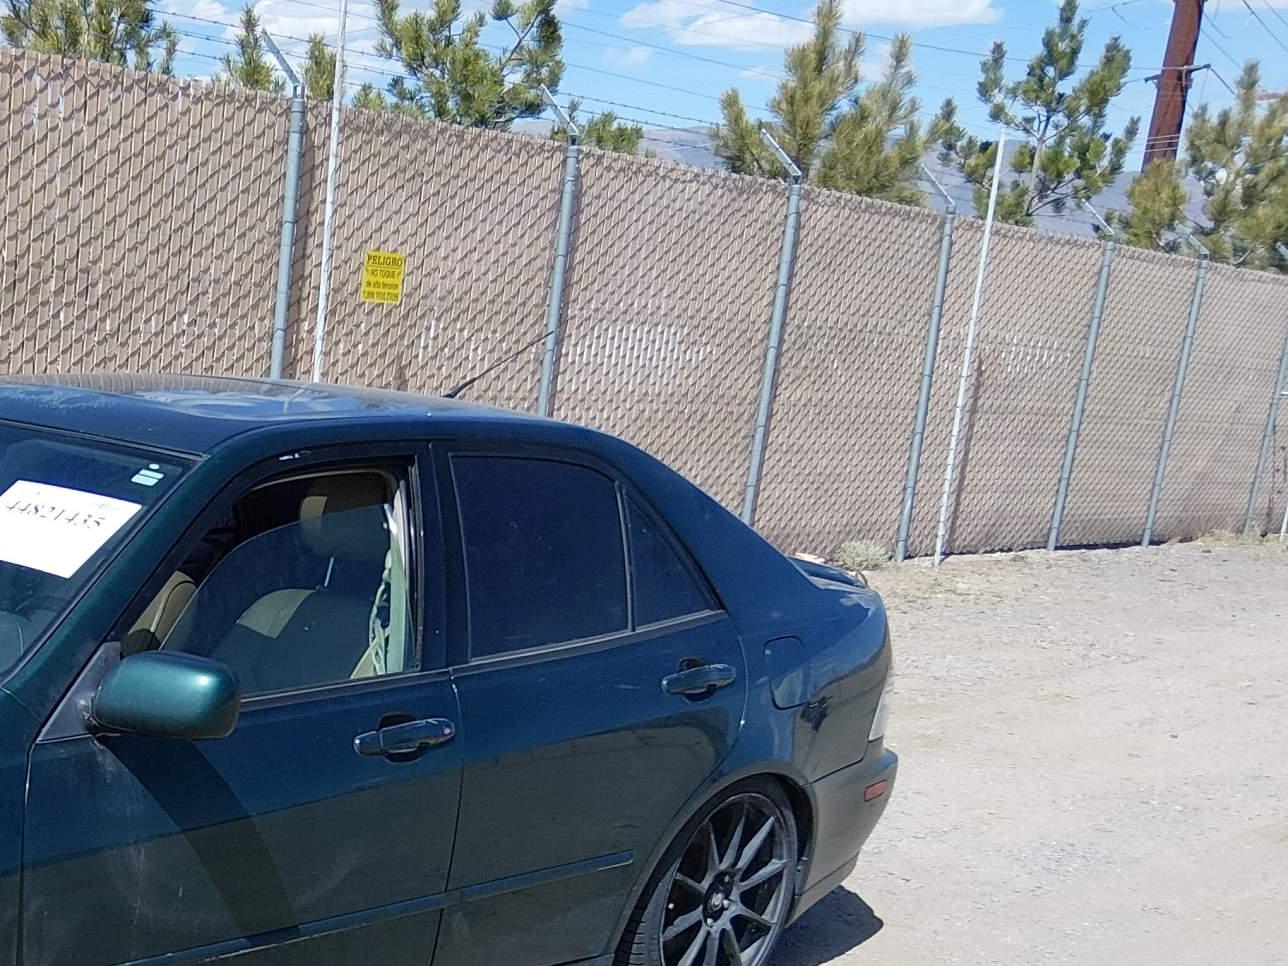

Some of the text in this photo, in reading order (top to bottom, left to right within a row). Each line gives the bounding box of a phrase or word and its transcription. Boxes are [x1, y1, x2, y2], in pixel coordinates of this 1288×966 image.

[367, 255, 403, 267] PELIGRO
[370, 269, 378, 278] NO
[380, 270, 396, 279] TOQUE
[6, 500, 106, 529] 44821435
